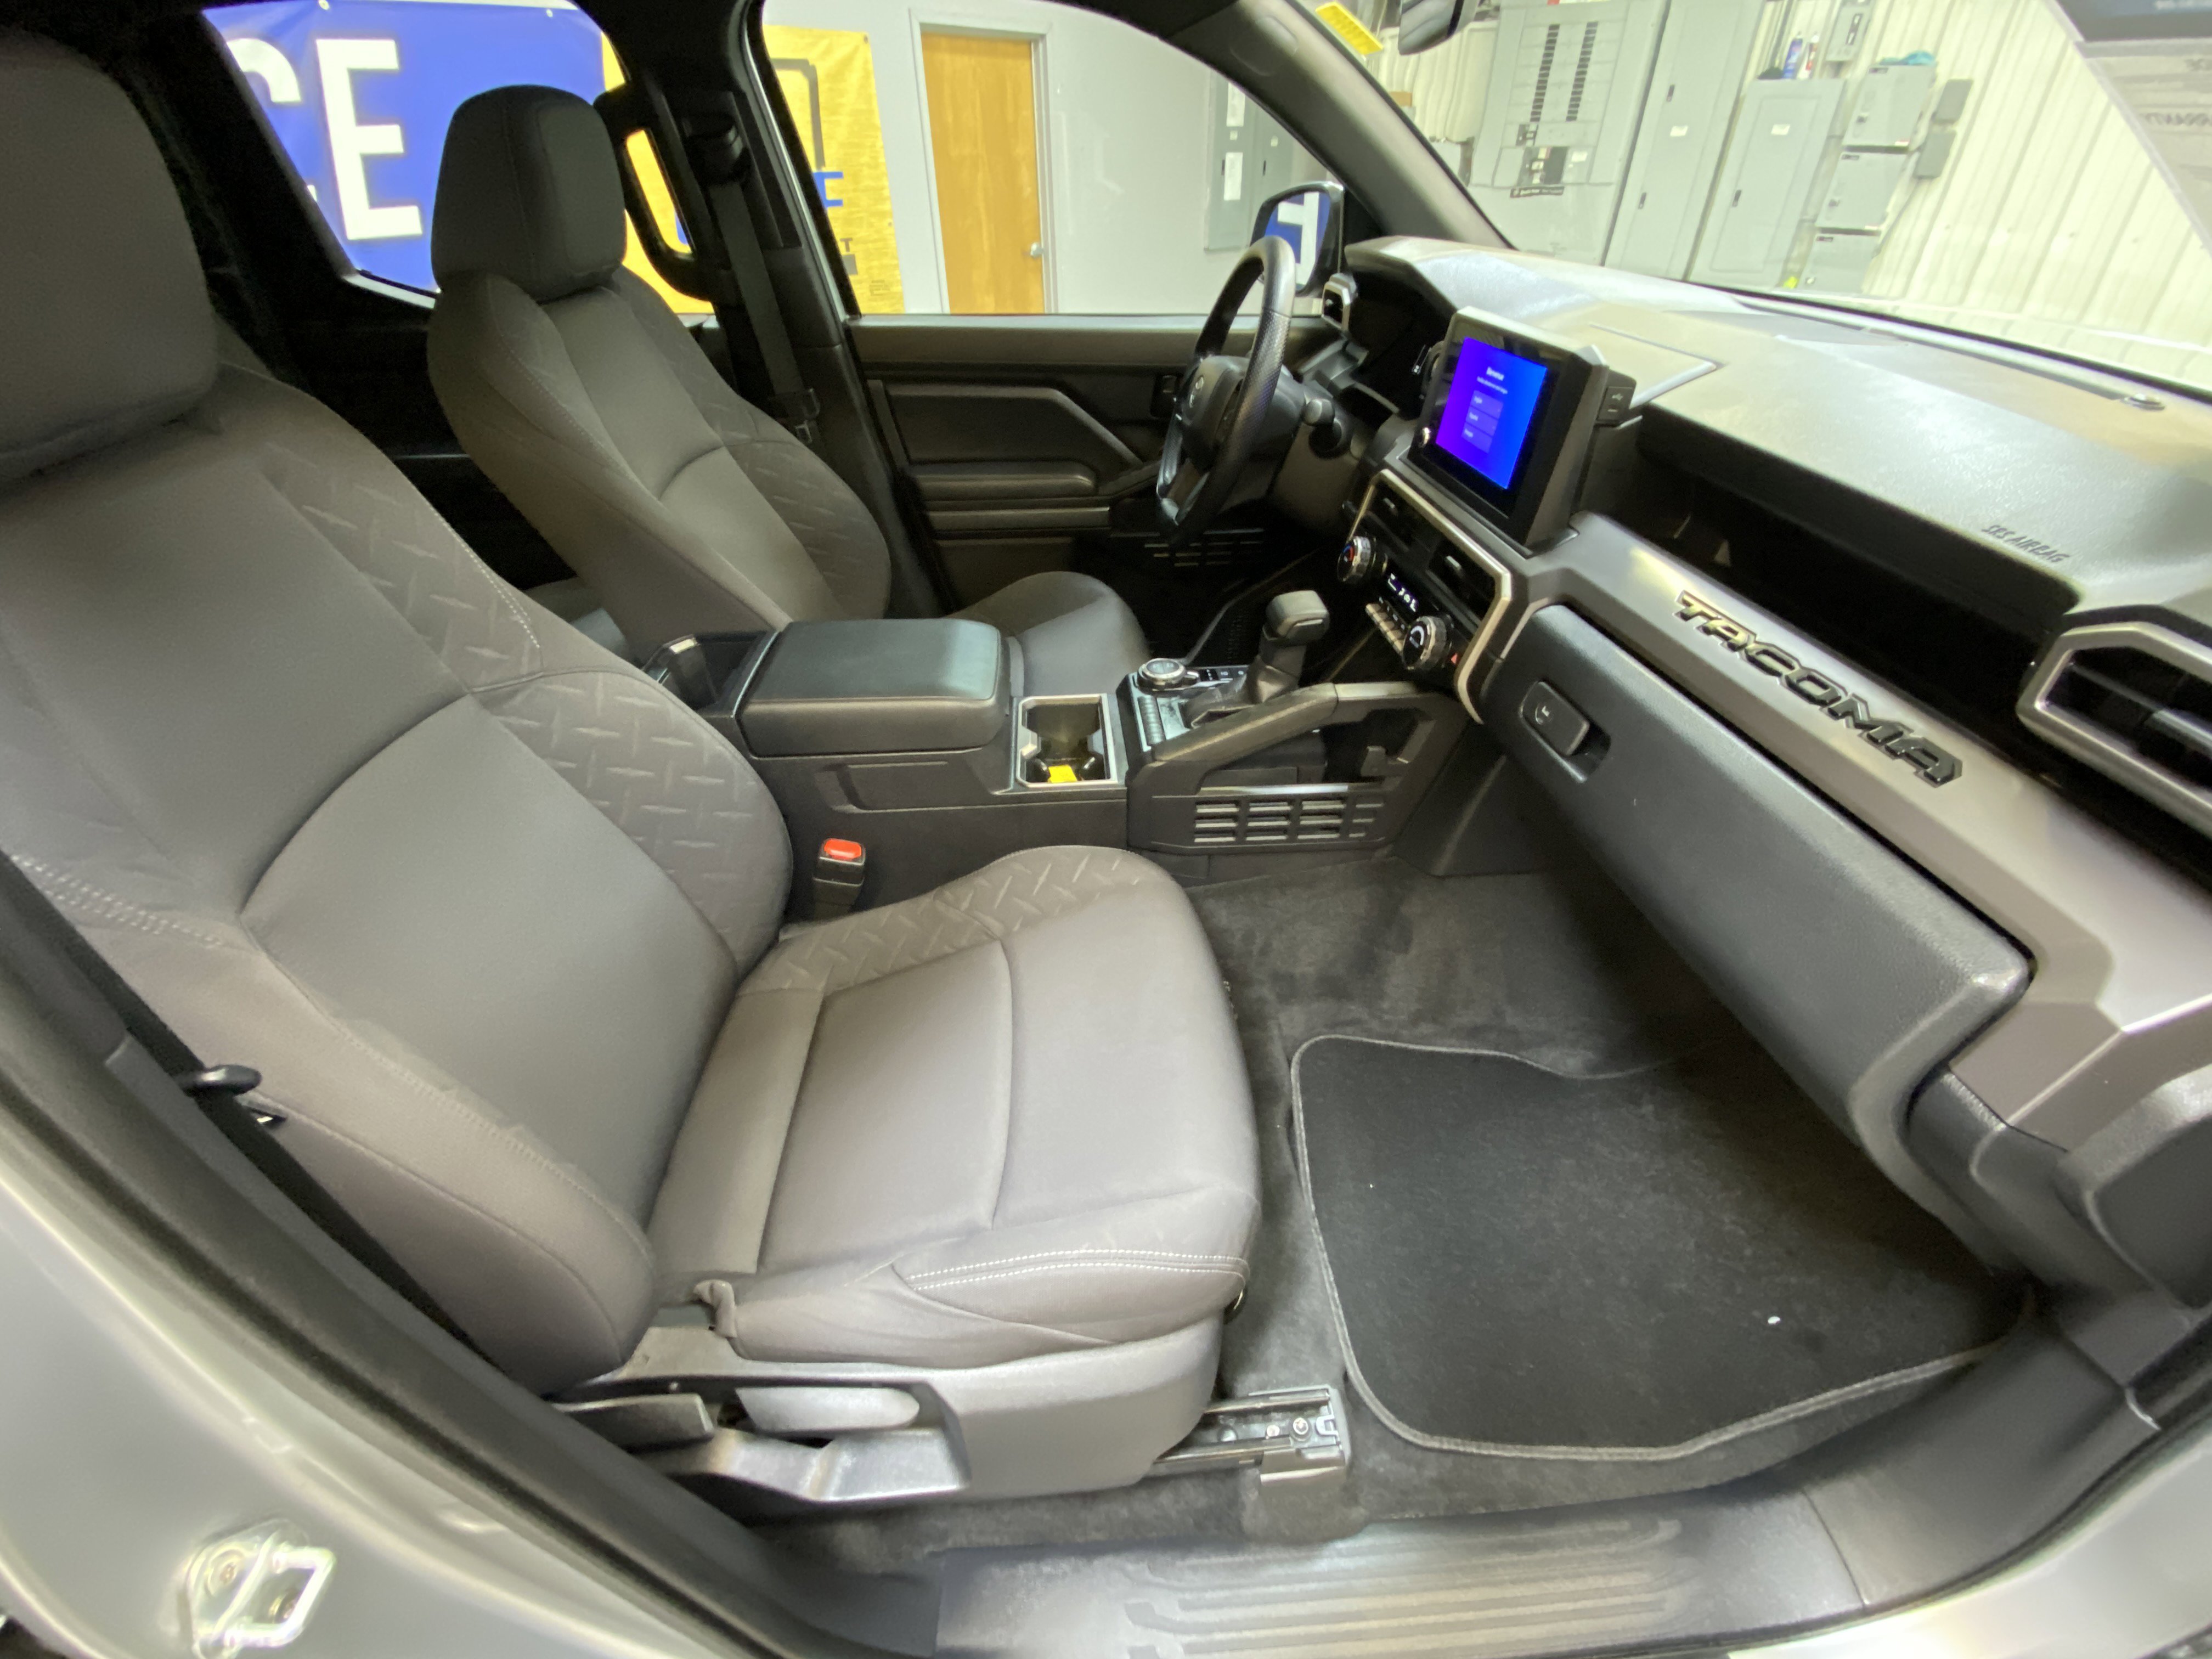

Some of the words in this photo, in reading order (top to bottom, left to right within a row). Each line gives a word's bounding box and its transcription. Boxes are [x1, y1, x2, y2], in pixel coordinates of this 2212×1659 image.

[1981, 524, 2016, 539] SRS
[2004, 535, 2070, 563] AIRBAG
[1674, 590, 1963, 788] TACOMA
